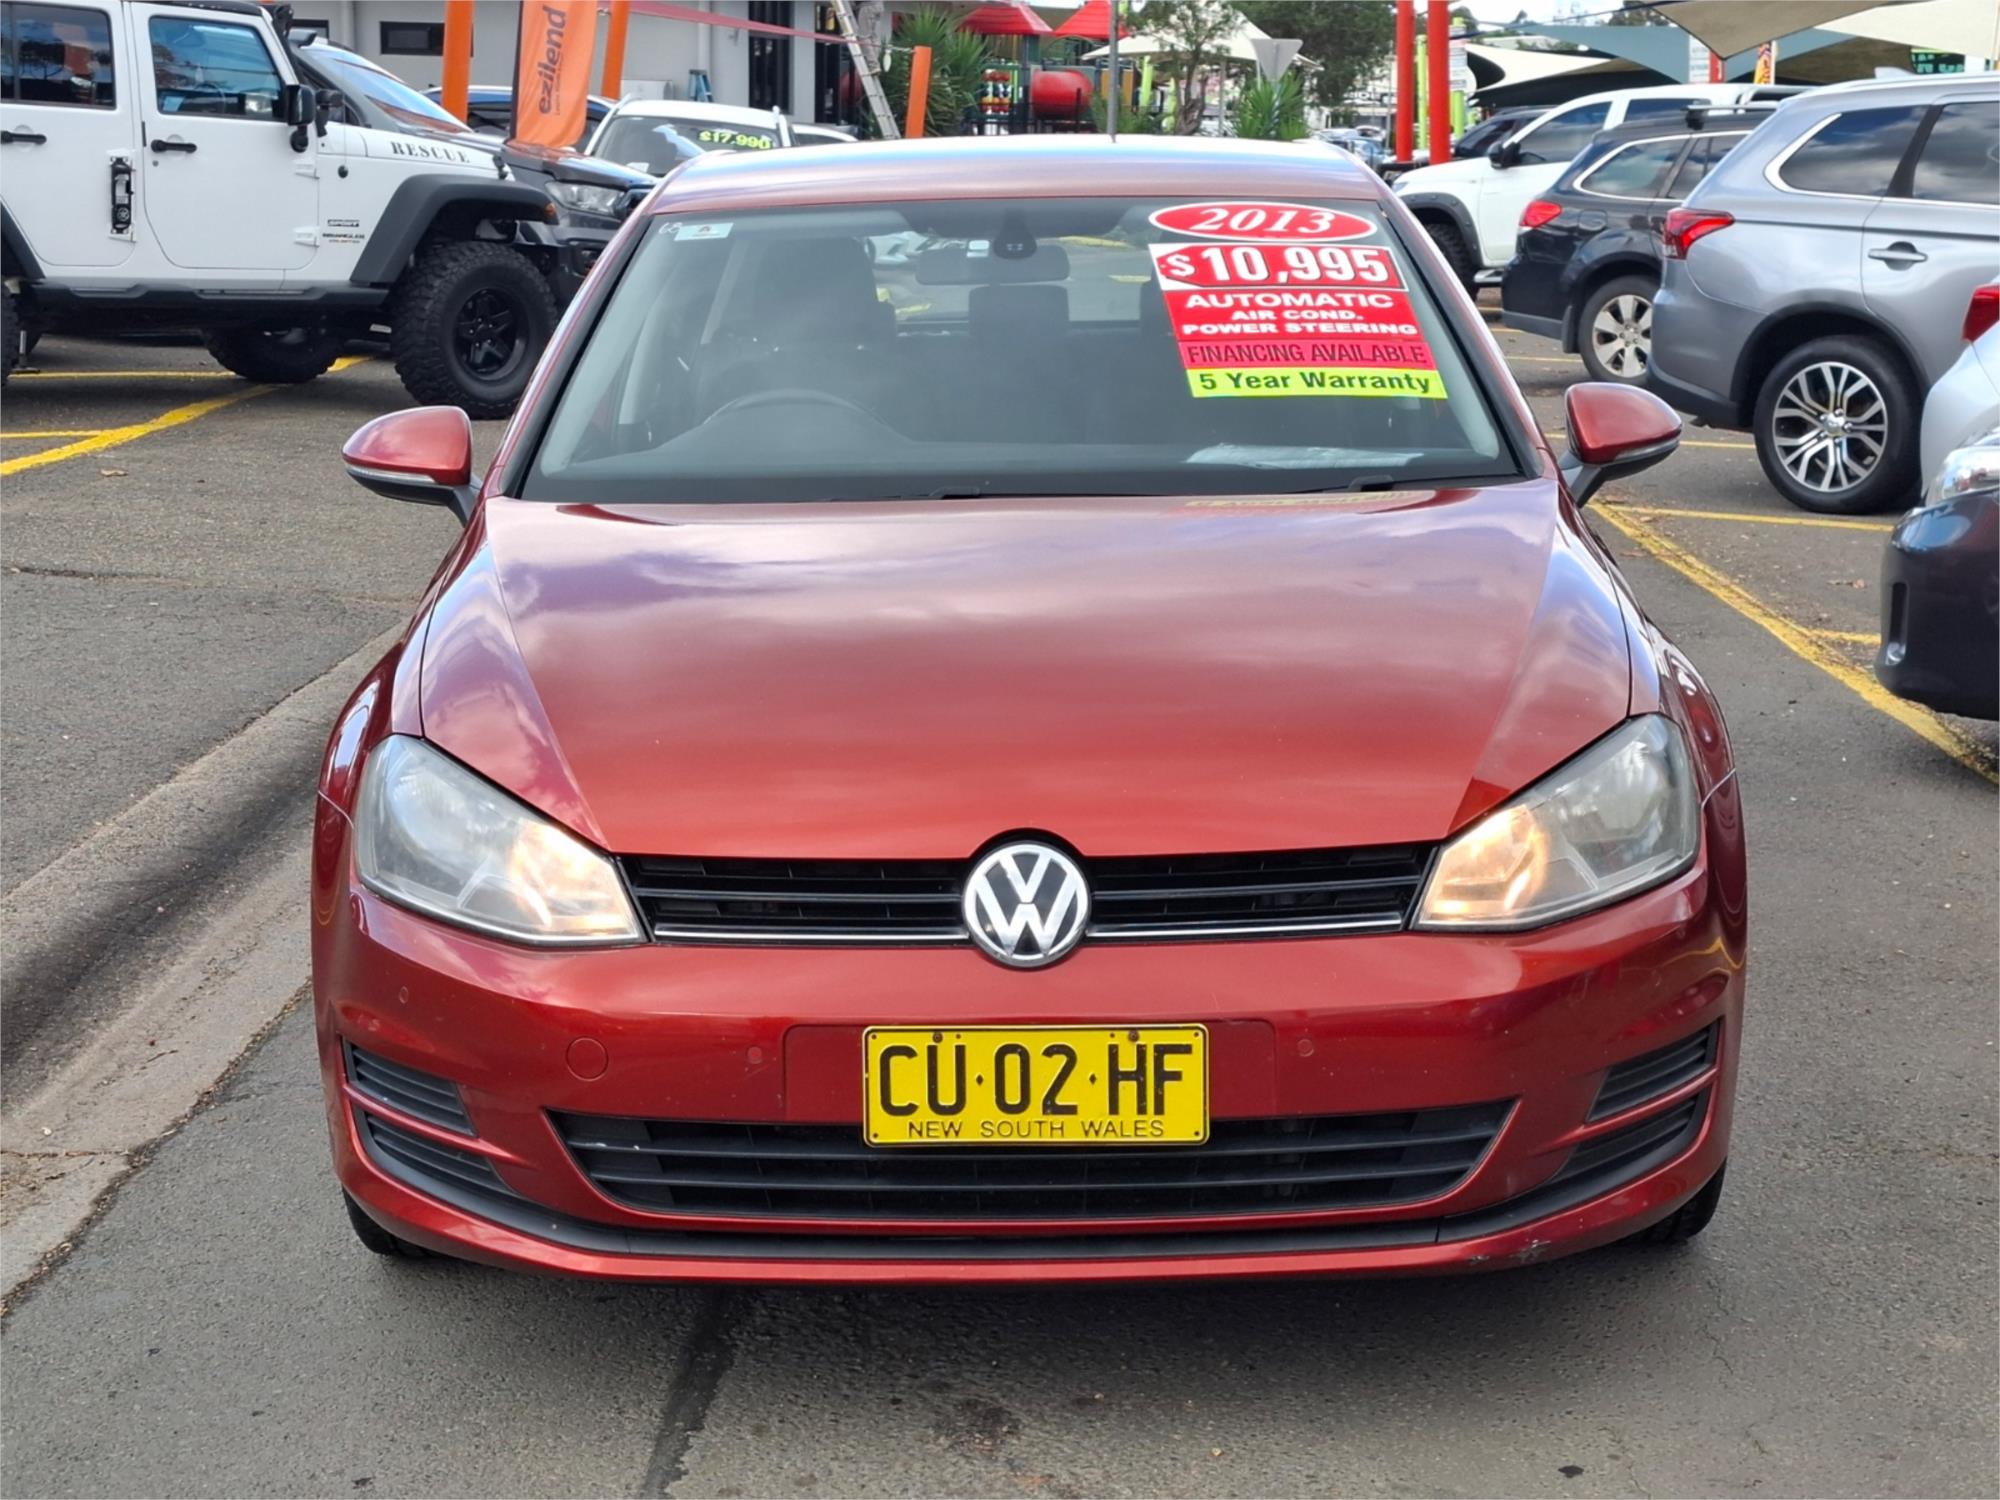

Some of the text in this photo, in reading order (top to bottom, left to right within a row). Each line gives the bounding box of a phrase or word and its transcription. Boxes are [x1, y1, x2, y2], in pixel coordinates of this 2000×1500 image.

[536, 4, 567, 115] ezilend
[390, 141, 471, 164] RESCUE
[1188, 207, 1336, 234] 2013
[1165, 247, 1390, 283] $10,995
[1185, 293, 1395, 309] AUTOMATIC
[1230, 309, 1364, 321] AIR COND.
[1181, 321, 1418, 336] POWER STEERING
[1186, 343, 1427, 364] FINANCING AVAILABLE
[1200, 372, 1431, 393] 5 Year Warranty
[907, 1119, 1165, 1139] NEW SOUTH WALES
